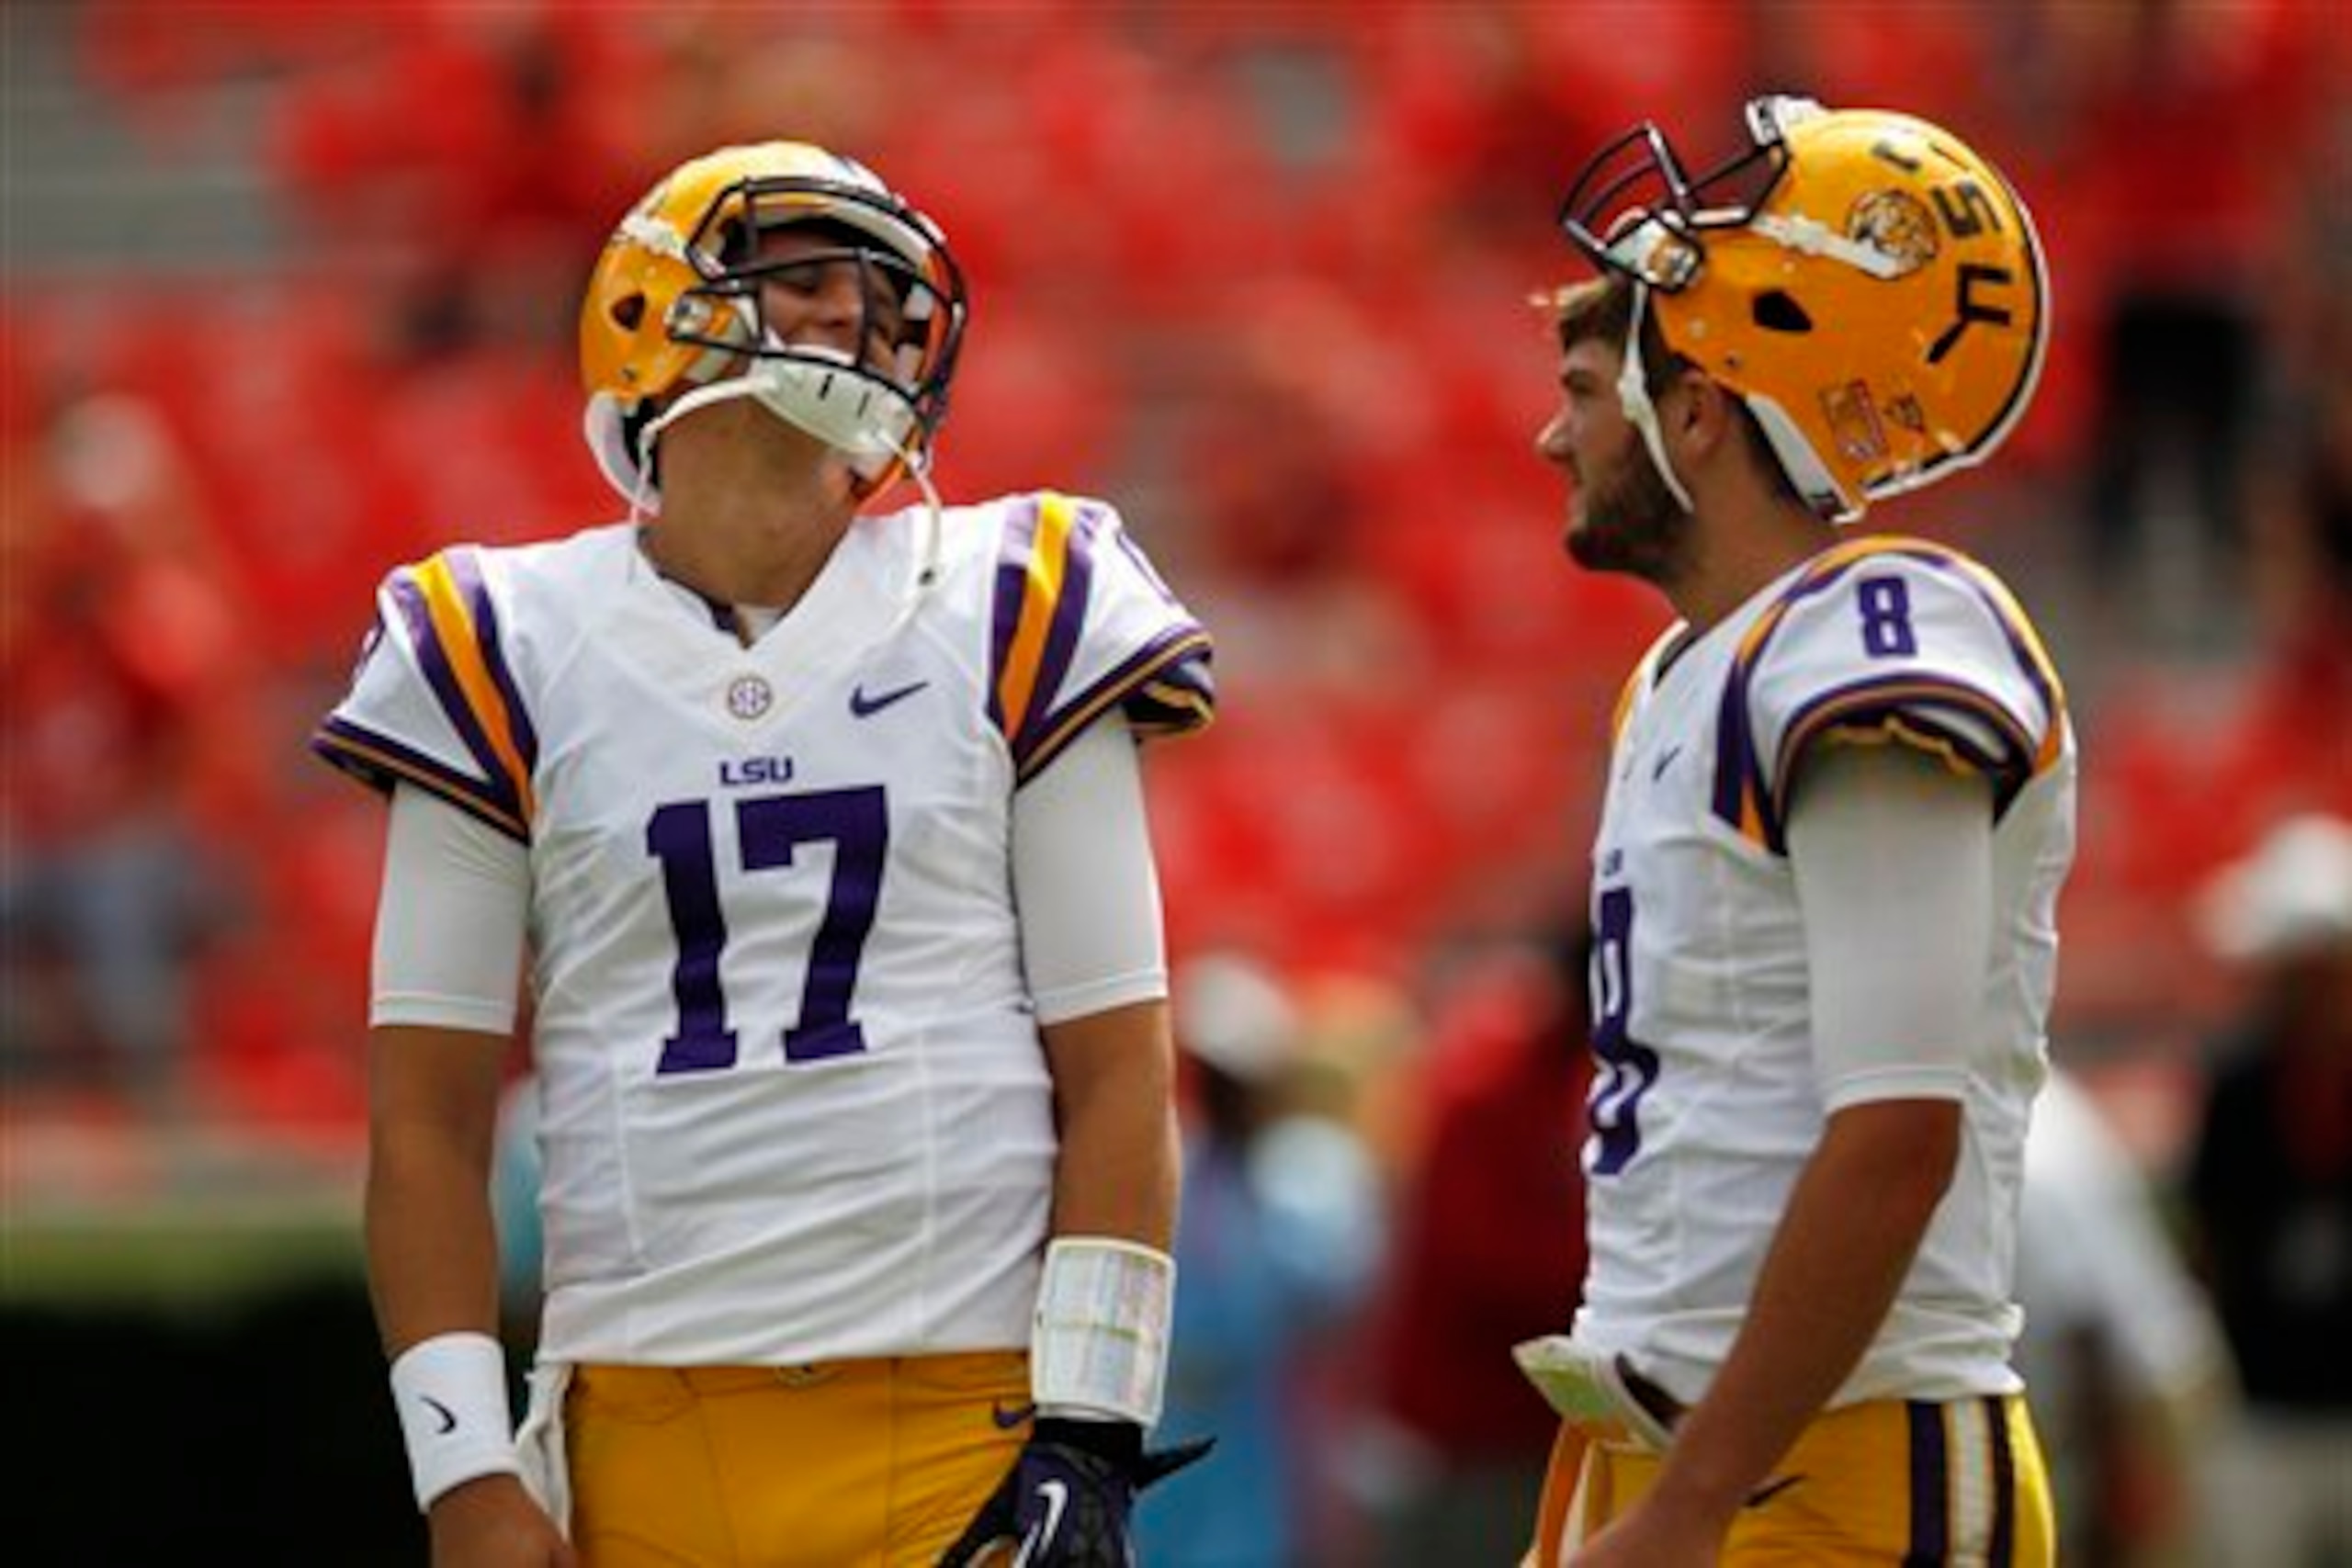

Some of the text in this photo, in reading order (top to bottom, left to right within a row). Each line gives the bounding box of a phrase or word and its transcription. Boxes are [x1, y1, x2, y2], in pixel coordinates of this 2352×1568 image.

[1871, 141, 2012, 364] LSU
[1858, 577, 1918, 659] 8
[719, 756, 794, 786] LSU
[646, 785, 888, 1076] 17
[1590, 886, 1661, 1176] 8
